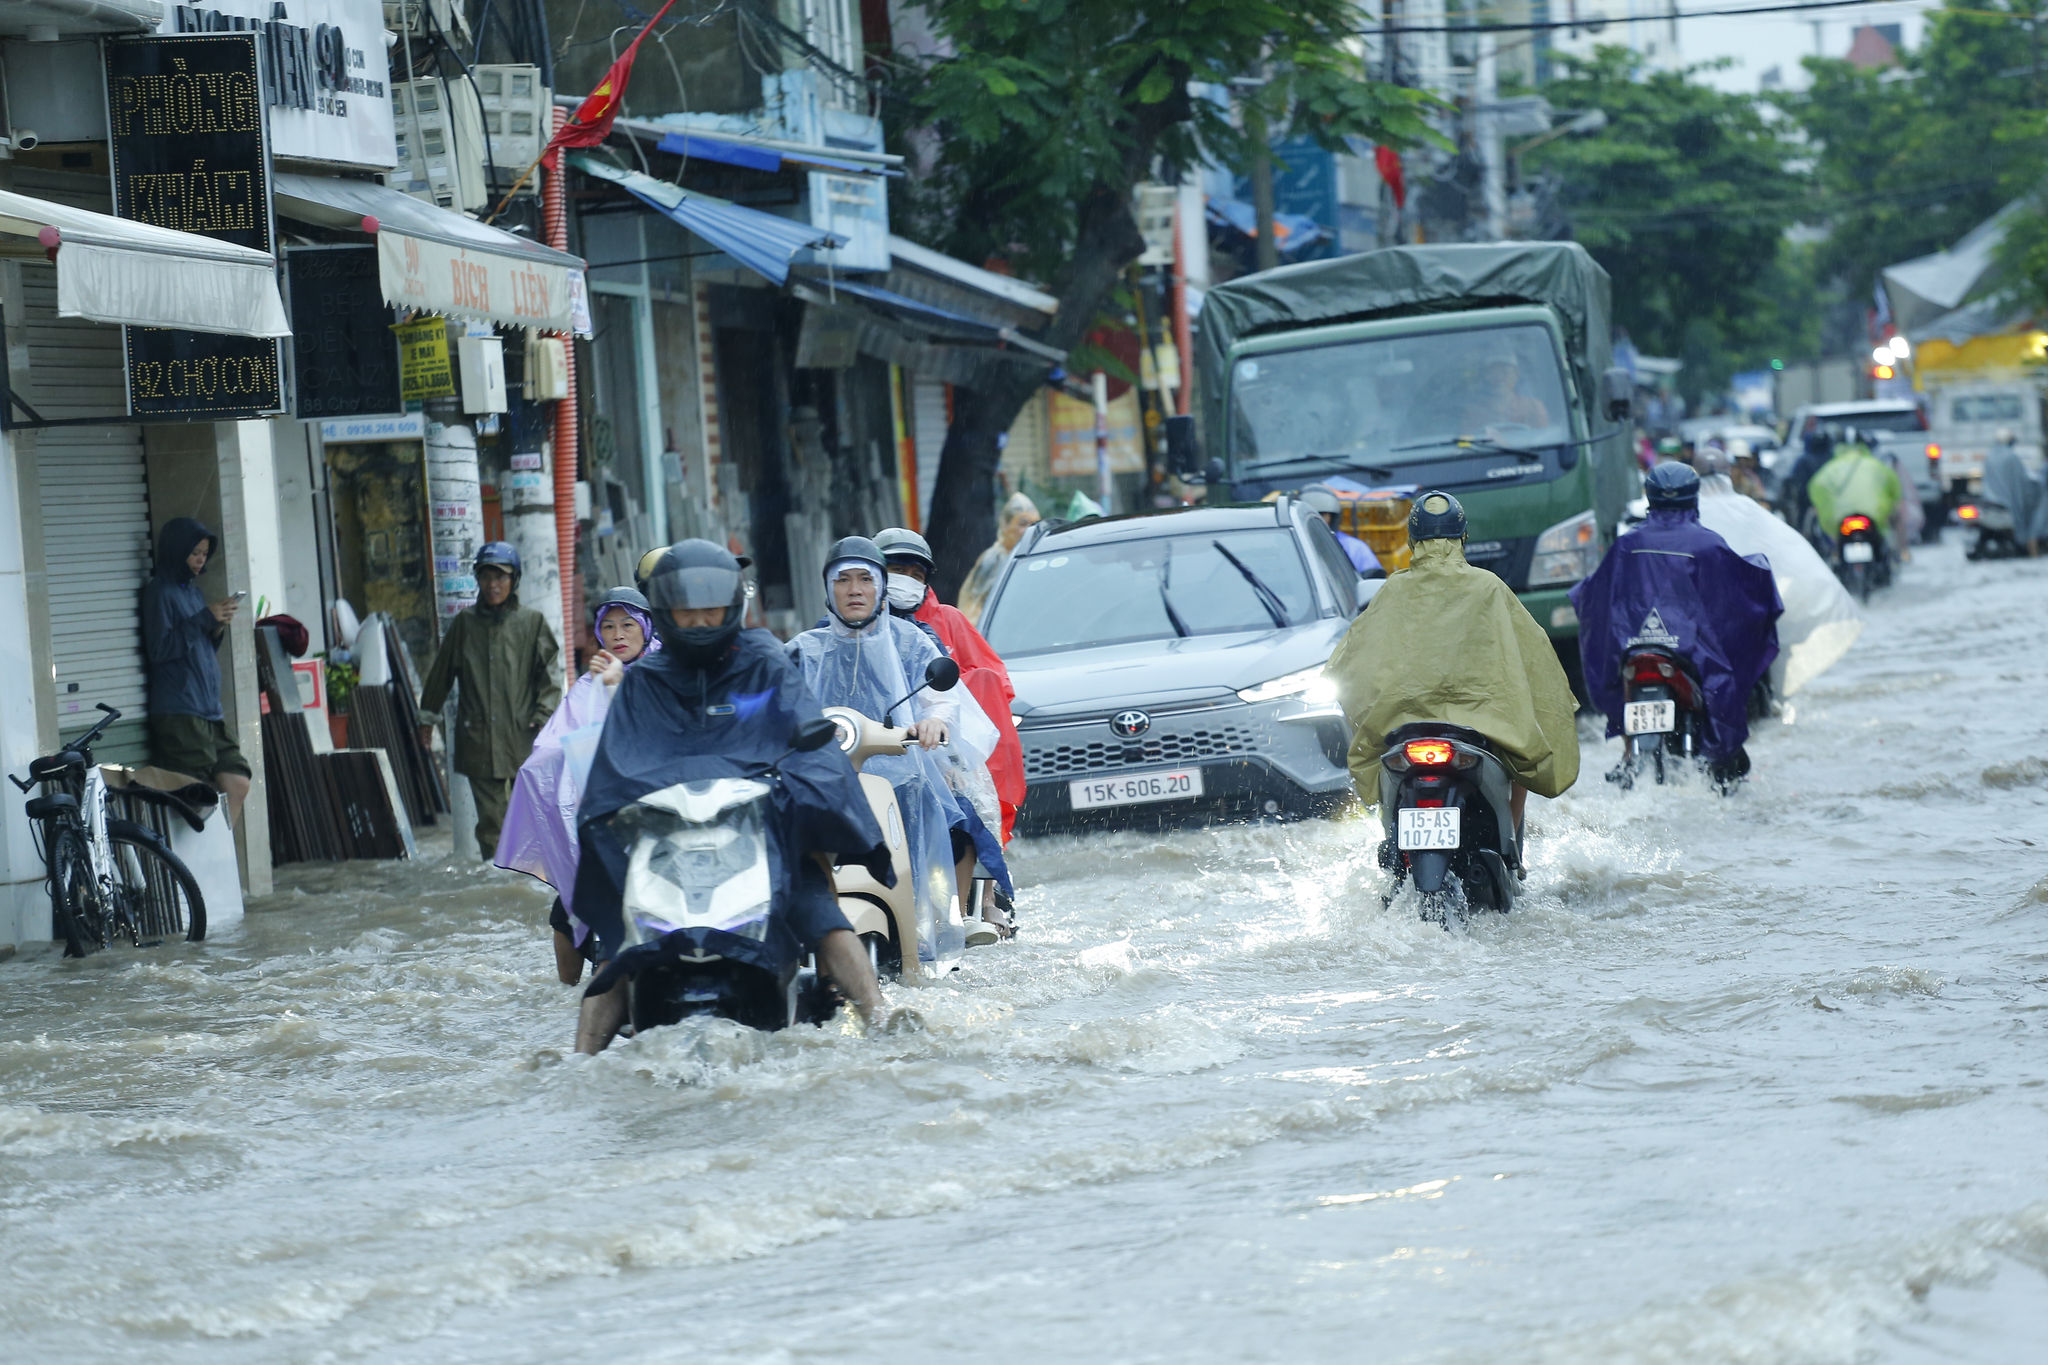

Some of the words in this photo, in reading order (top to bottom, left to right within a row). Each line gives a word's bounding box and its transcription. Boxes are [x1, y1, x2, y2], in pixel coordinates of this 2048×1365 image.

[116, 58, 255, 136] PHÒNG
[130, 159, 254, 232] KHÁM
[451, 248, 489, 312] BÍCH
[511, 262, 549, 319] LIÊN
[137, 361, 165, 398] 92
[168, 355, 219, 401] CHỢ
[223, 356, 272, 395] CON
[1084, 775, 1191, 803] 15K-606.20
[1404, 829, 1456, 847] 107.45
[1410, 811, 1451, 828] 15-AS
